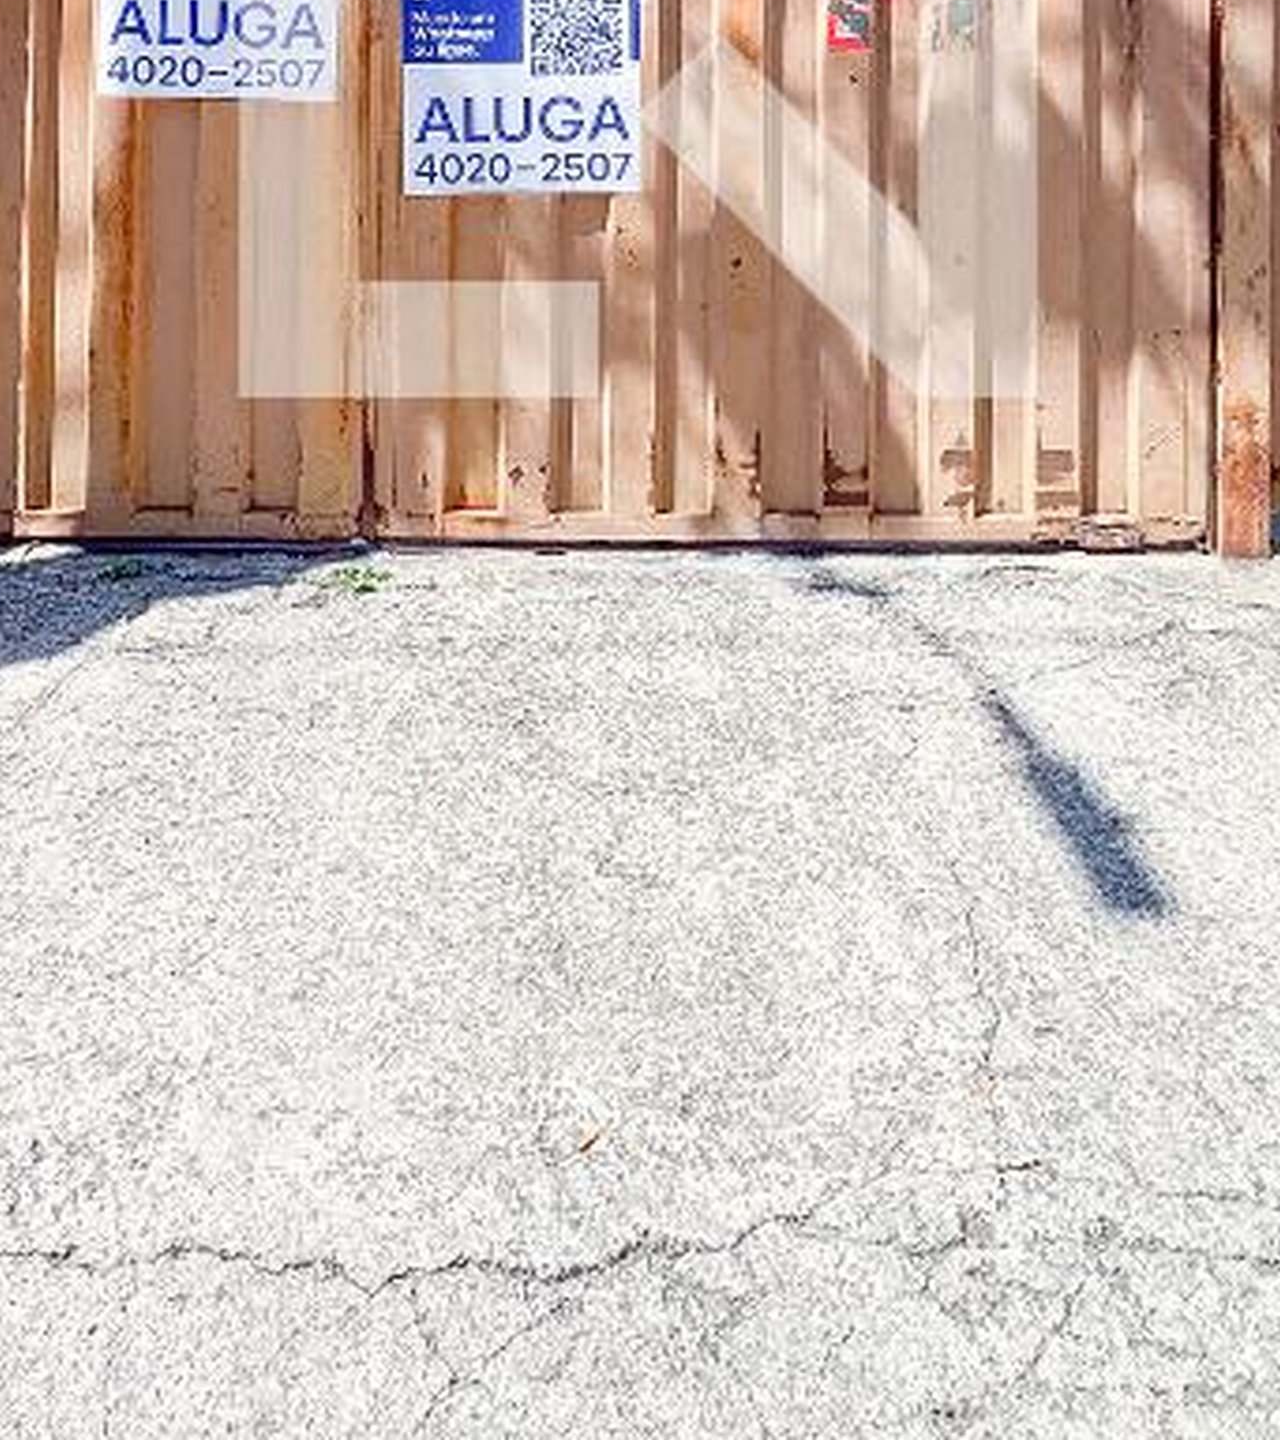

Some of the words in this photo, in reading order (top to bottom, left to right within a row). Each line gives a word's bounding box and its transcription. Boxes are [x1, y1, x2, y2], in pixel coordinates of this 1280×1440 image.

[110, 0, 323, 50] ALUGA
[107, 56, 323, 88] 4020-2507
[414, 96, 631, 144] ALUGA
[414, 153, 633, 184] 4020-2507
